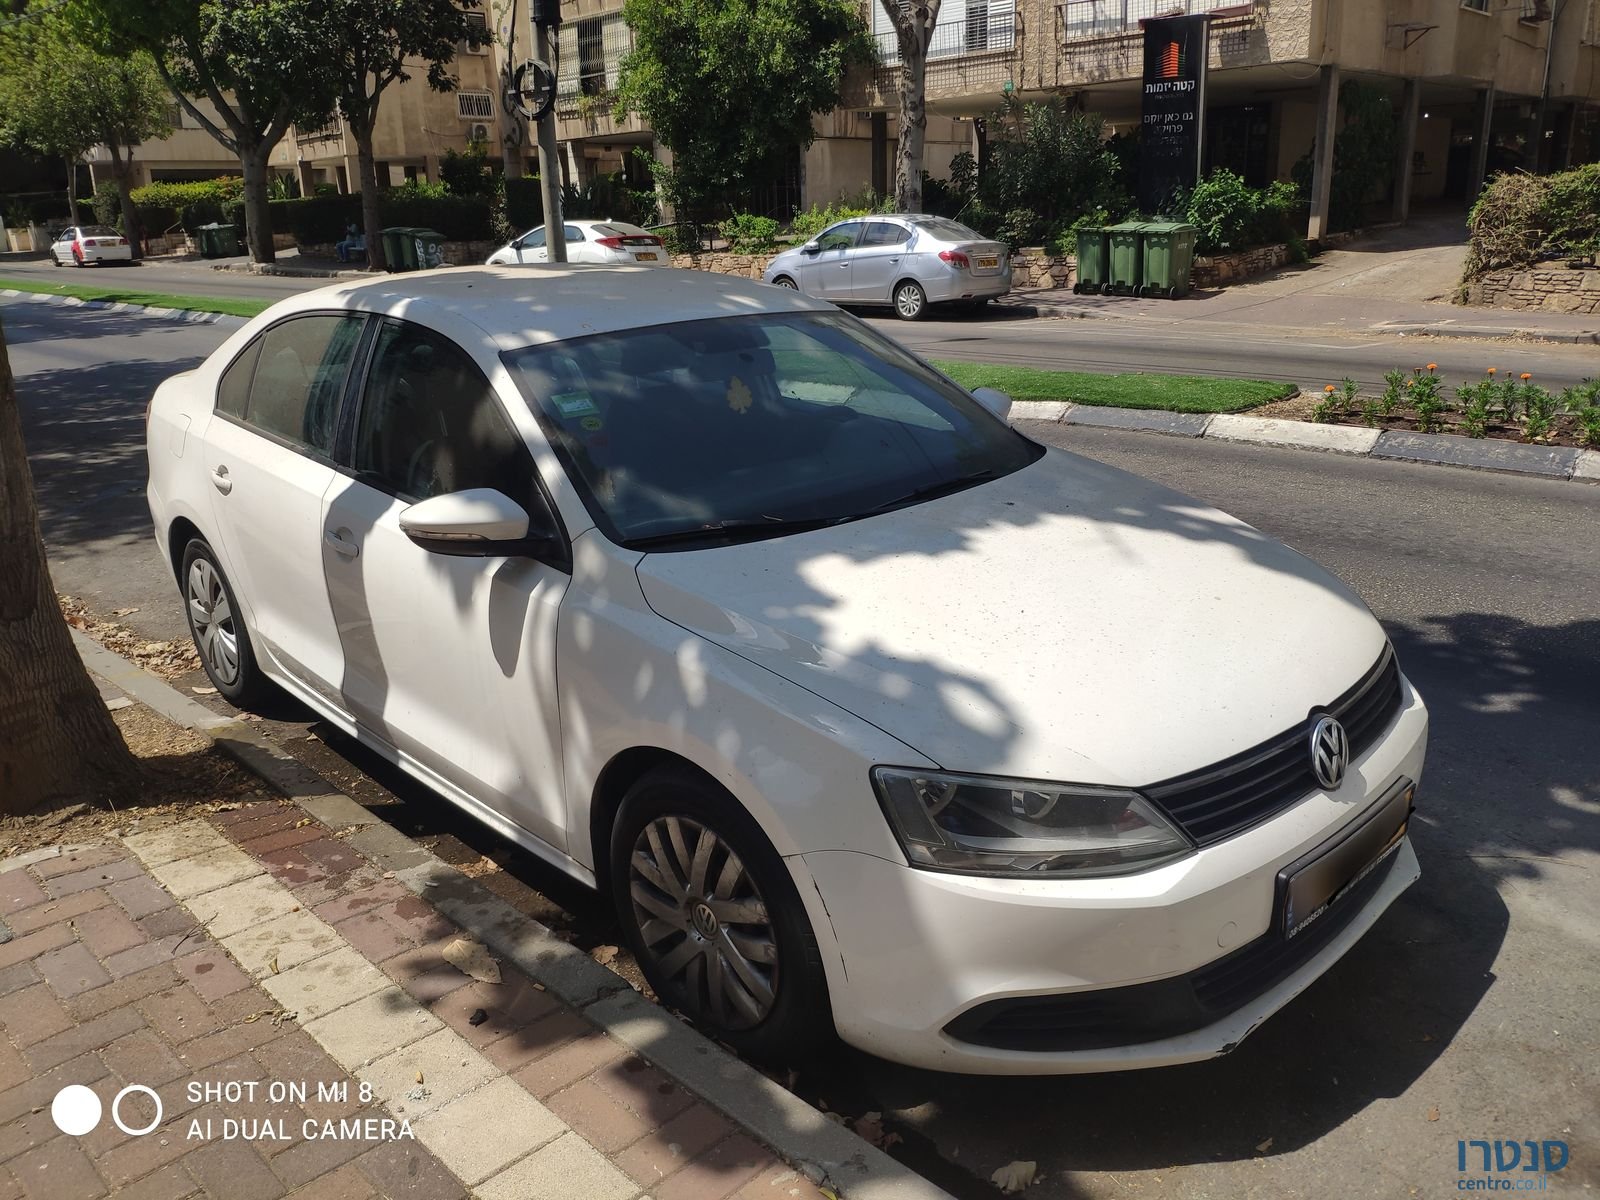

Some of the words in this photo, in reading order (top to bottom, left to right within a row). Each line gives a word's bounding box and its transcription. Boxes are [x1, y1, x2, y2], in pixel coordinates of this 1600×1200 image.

[1145, 82, 1171, 93] יזמות
[1173, 80, 1195, 92] קטה
[1144, 114, 1162, 125] יוקם
[1164, 113, 1180, 124] כאן
[1182, 112, 1193, 121] גם
